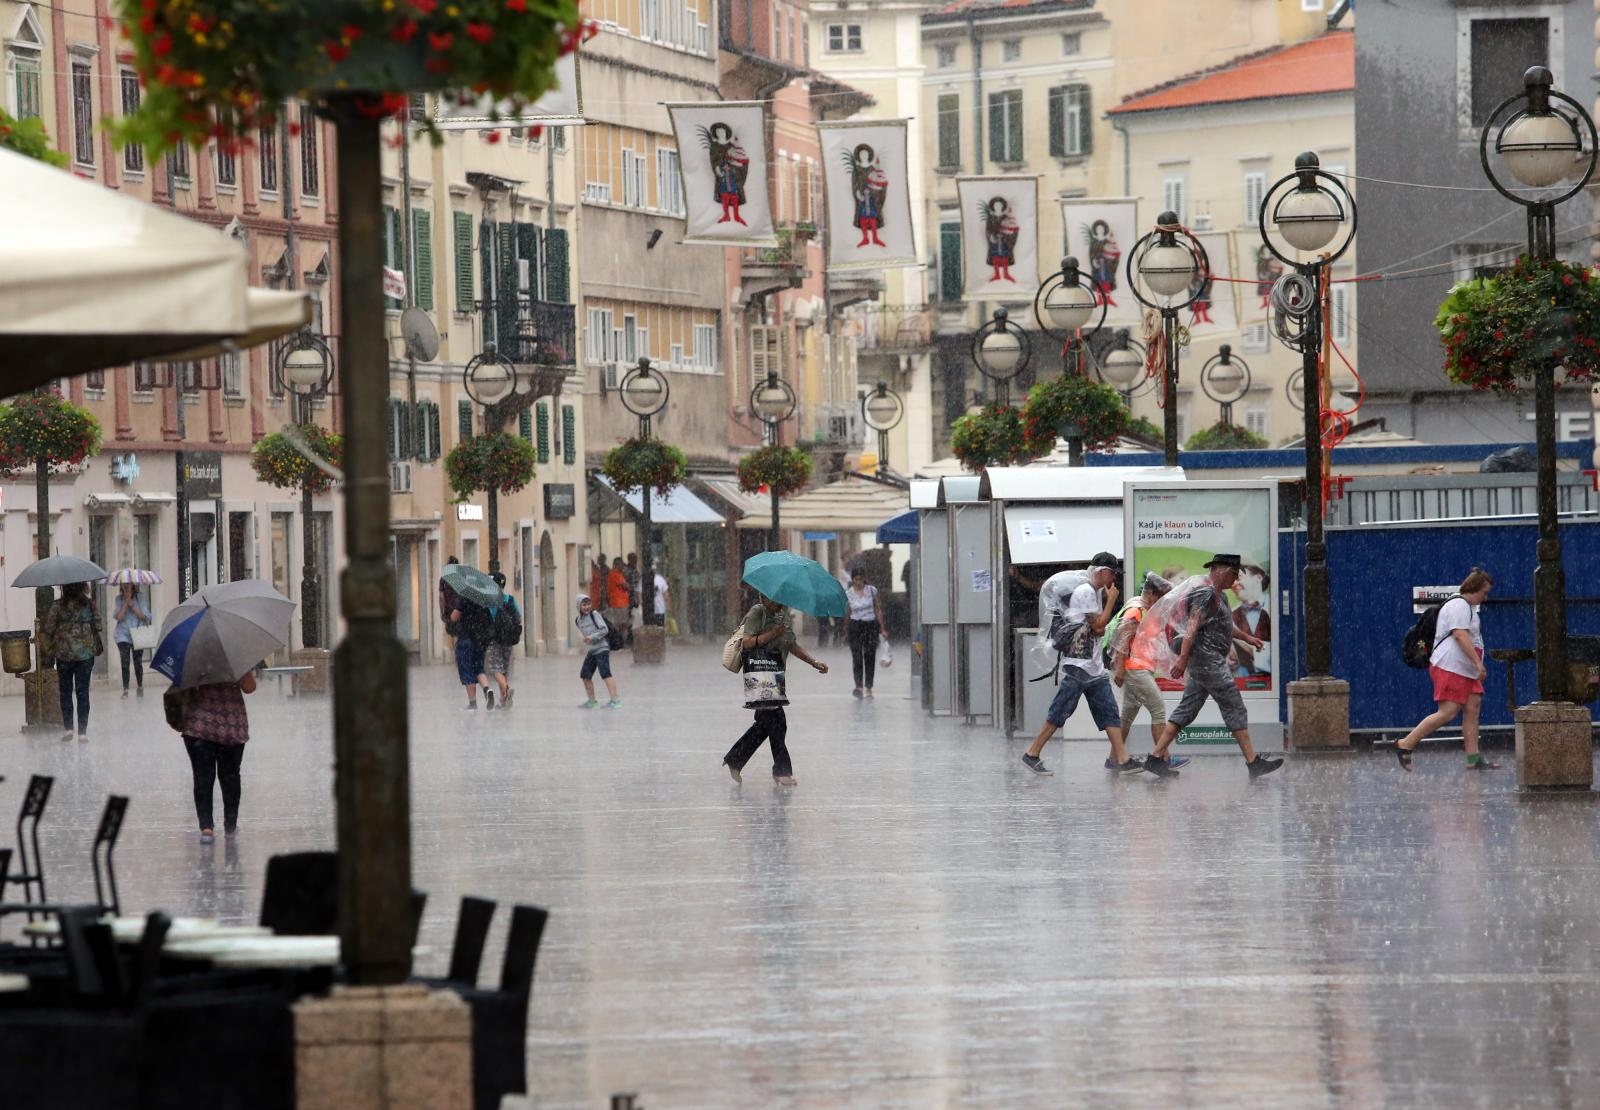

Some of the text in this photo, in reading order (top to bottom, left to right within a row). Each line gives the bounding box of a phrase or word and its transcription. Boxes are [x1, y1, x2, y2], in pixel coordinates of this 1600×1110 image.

[1138, 521, 1154, 529] Kad
[1155, 521, 1163, 531] je
[1164, 521, 1187, 529] klaun
[1194, 521, 1224, 529] bolnici,
[1138, 532, 1146, 541] ja
[1164, 532, 1191, 540] hrabra
[1189, 730, 1233, 739] europlakat
